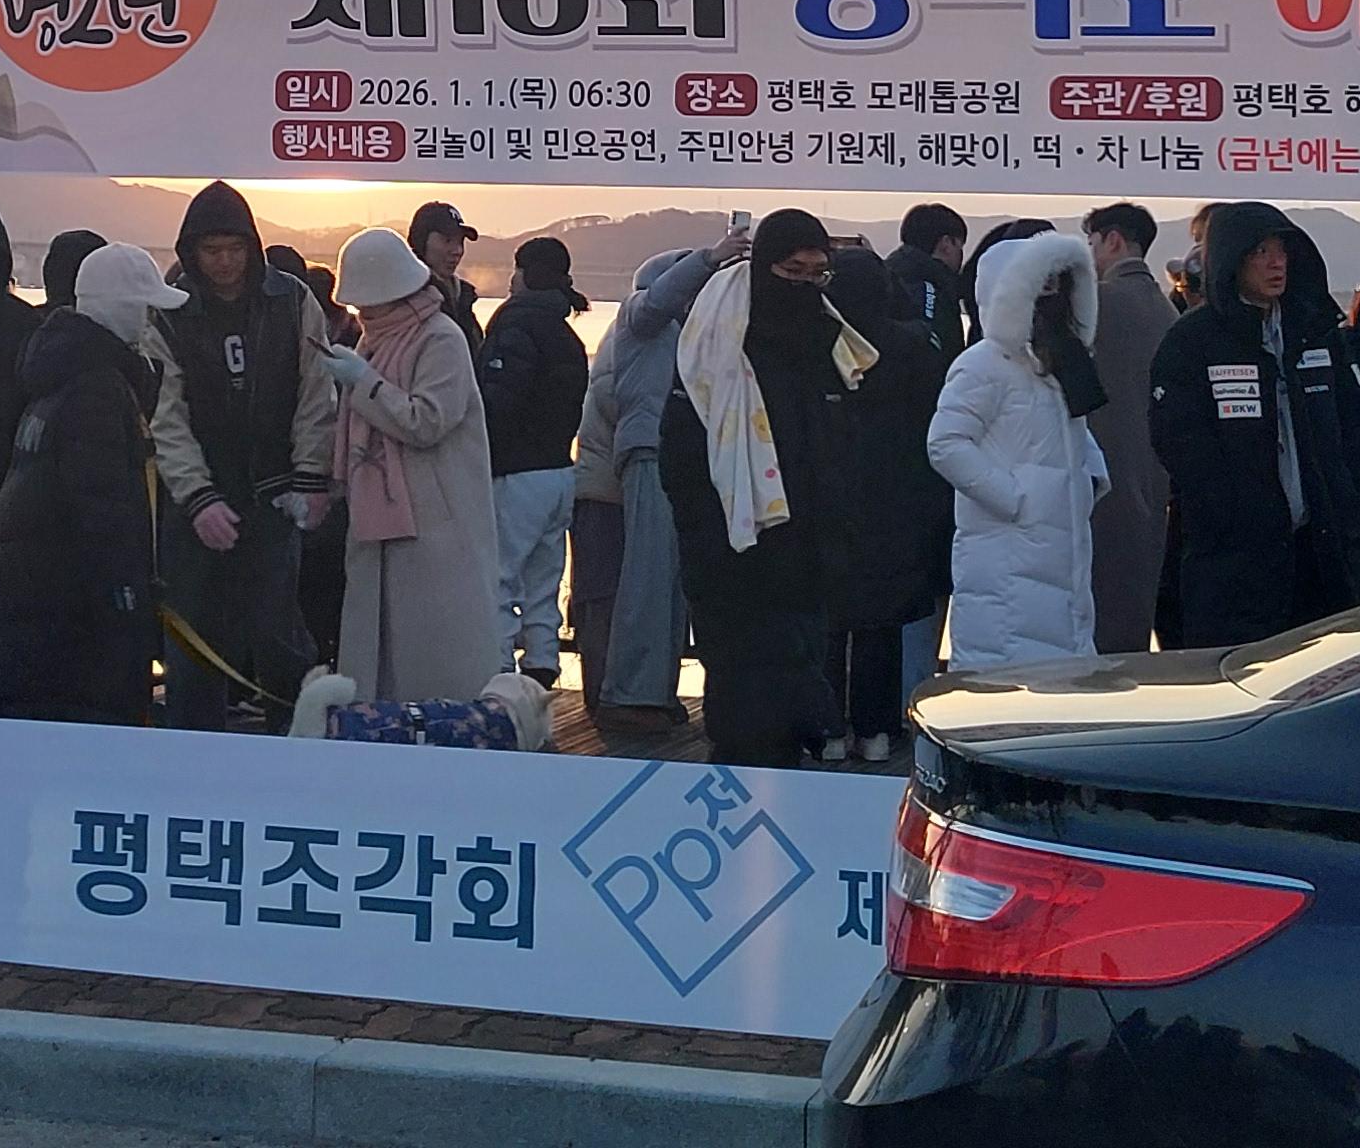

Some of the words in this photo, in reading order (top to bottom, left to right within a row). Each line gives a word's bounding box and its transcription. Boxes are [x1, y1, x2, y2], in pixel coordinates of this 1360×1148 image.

[286, 75, 338, 108] 일시
[359, 78, 437, 107] 2026.
[569, 80, 651, 108] 06:30
[686, 77, 747, 111] 장소
[767, 79, 856, 113] 평택호
[866, 79, 1021, 115] 모래톱공원
[1059, 80, 1208, 117] 주관/후원
[1233, 82, 1333, 119] 평택호
[281, 124, 392, 159] 행사내용
[413, 126, 495, 160] 길놀이
[506, 128, 532, 161] 및
[544, 128, 666, 164] 민요공연,
[678, 129, 795, 164] 주민안녕
[807, 132, 906, 168] 기원제,
[918, 131, 1020, 170] 해맞이,
[1033, 134, 1062, 169] 떡
[1096, 134, 1129, 170] 차
[1140, 136, 1204, 171] 나눔
[224, 335, 245, 373] G
[72, 809, 536, 950] 평택조각회
